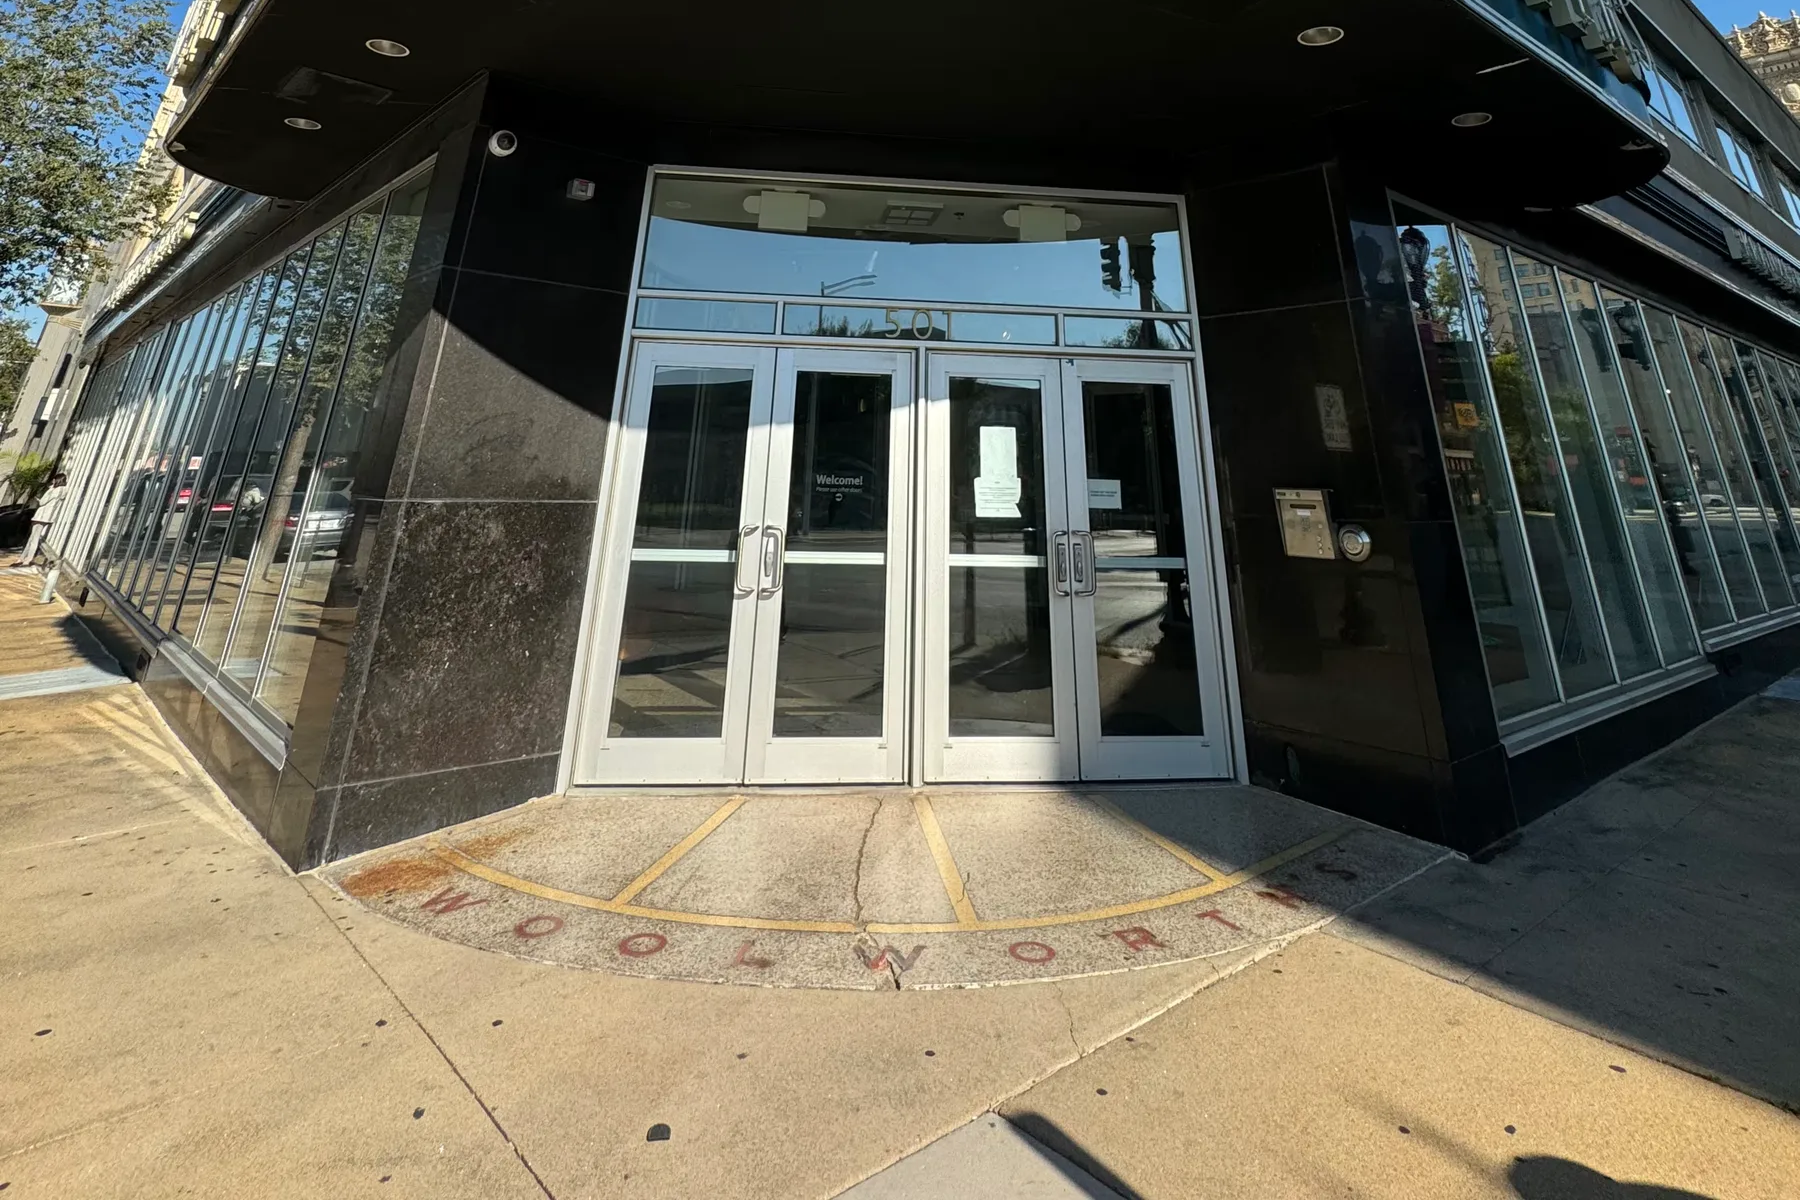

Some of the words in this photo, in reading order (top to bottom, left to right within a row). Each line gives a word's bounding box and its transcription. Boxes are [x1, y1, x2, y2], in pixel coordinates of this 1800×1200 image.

[884, 307, 952, 341] 501
[816, 474, 863, 486] Welcome!
[419, 861, 1358, 973] WOOLWORTHS
